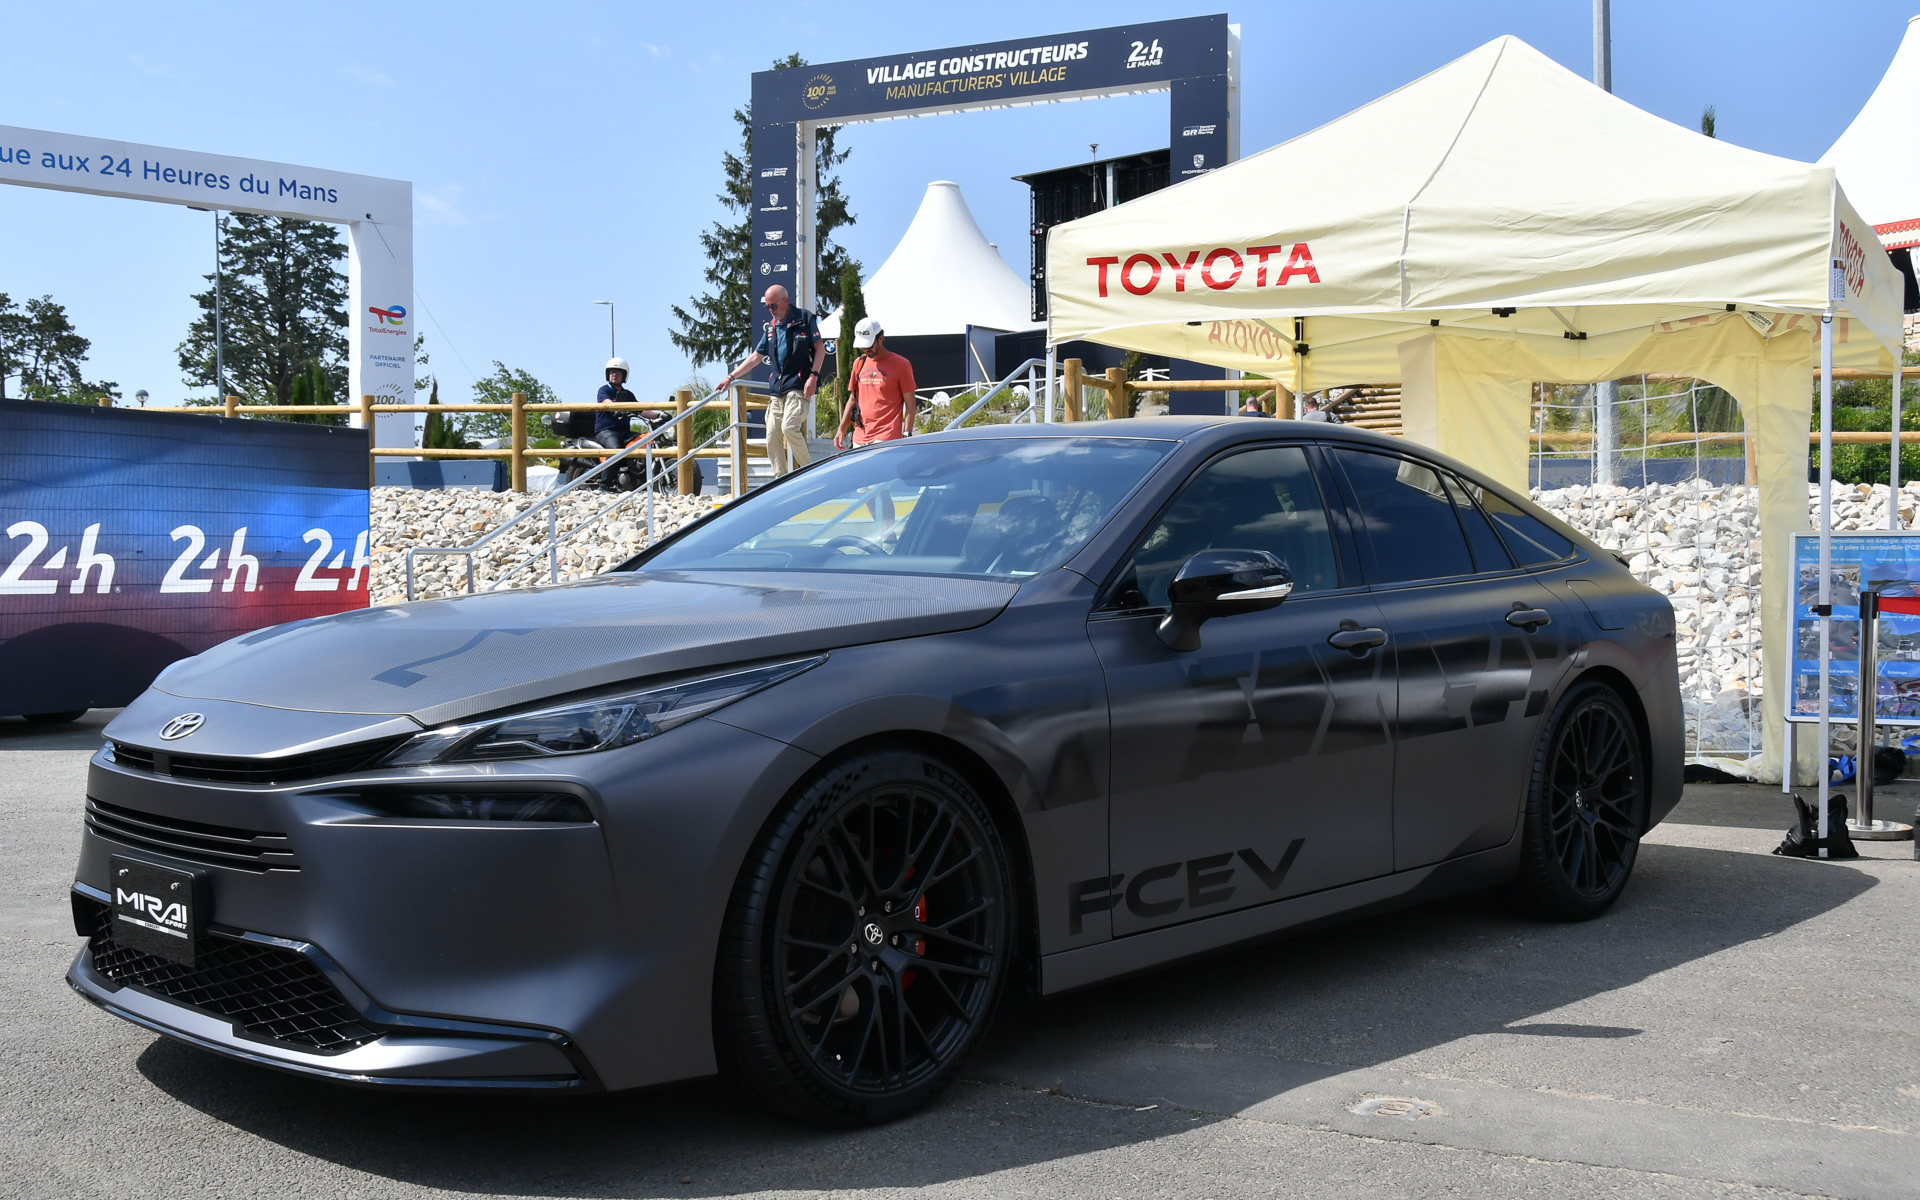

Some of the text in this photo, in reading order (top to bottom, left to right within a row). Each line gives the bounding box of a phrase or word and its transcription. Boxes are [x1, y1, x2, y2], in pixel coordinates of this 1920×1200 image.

[866, 41, 1089, 84] VILLAGE CONSTRUCTEURS
[1126, 58, 1162, 69] LE MANS
[1128, 38, 1164, 62] 24h
[806, 85, 826, 98] 100
[885, 66, 1067, 101] MANUFACTURERS' VILLAGE
[41, 152, 90, 173] aux
[99, 155, 133, 178] 24
[143, 160, 230, 190] Heures
[239, 173, 269, 195] du
[278, 178, 338, 203] Mans
[1086, 242, 1321, 298] TOYOTA
[368, 326, 407, 336] TotalEnergies
[369, 354, 406, 363] PARTENAIRE
[374, 361, 402, 369] OFFICIEL
[374, 394, 396, 405] 100
[0, 520, 116, 595] 24h
[160, 524, 260, 594] 24h
[942, 774, 995, 837] MICHELIN
[1068, 837, 1306, 936] FCEV
[116, 887, 188, 924] MIRAI
[164, 918, 188, 930] SPORT
